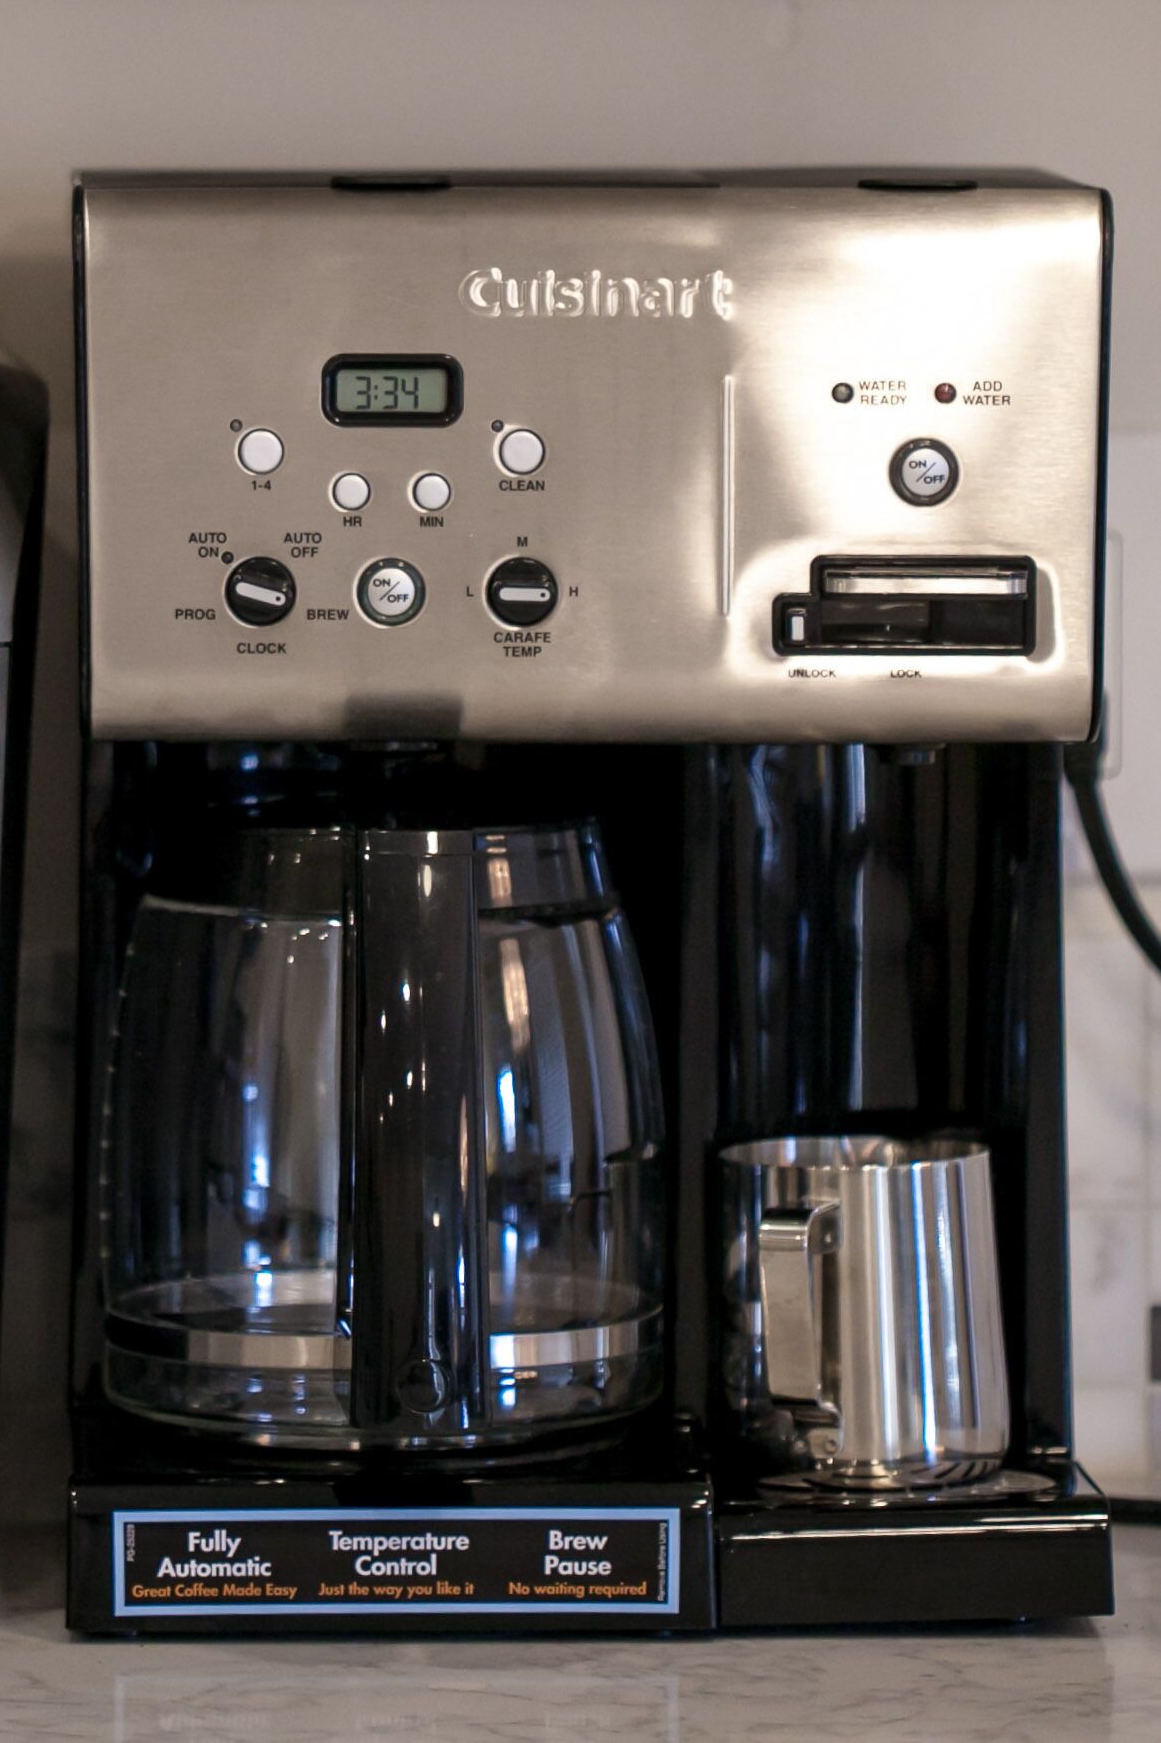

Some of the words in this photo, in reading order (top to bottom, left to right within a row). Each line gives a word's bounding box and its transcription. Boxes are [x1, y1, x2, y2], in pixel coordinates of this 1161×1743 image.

[459, 267, 735, 320] Cuisinart
[858, 380, 906, 391] WATER
[972, 380, 1003, 392] ADD
[355, 375, 419, 410] 3:34
[860, 394, 907, 406] READY
[962, 394, 1011, 406] WATER
[251, 480, 272, 491] 1-4
[498, 480, 546, 491] CLEAN
[342, 516, 363, 528] HR
[419, 516, 444, 528] MIN
[188, 532, 227, 544] AUTO
[283, 532, 323, 544] AUTO
[517, 536, 528, 547] M
[198, 546, 219, 558] ON
[290, 546, 319, 558] OFF
[466, 586, 474, 597] L
[569, 586, 579, 597] H
[175, 608, 216, 621] PROG
[307, 608, 349, 621] BREW
[493, 632, 551, 644] CARAFE
[237, 642, 287, 655] CLOCK
[503, 646, 542, 658] TEMP
[788, 668, 836, 679] UNLOCK
[890, 669, 922, 679] LOCK
[188, 1529, 241, 1557] Fully
[328, 1530, 470, 1556] Temperature
[549, 1530, 608, 1550] Brew
[157, 1557, 272, 1578] Automatic
[355, 1553, 437, 1576] Control
[544, 1555, 612, 1575] Pause
[132, 1585, 171, 1598] Great
[174, 1583, 218, 1597] Coffee
[223, 1582, 262, 1596] Made
[265, 1583, 298, 1599] Easy
[318, 1583, 345, 1596] Just
[348, 1581, 370, 1595] the
[373, 1585, 403, 1599] way
[407, 1585, 432, 1599] you
[437, 1581, 461, 1595] like
[465, 1582, 475, 1595] it
[508, 1583, 530, 1595] No
[534, 1581, 585, 1598] waiting
[589, 1581, 647, 1600] required
